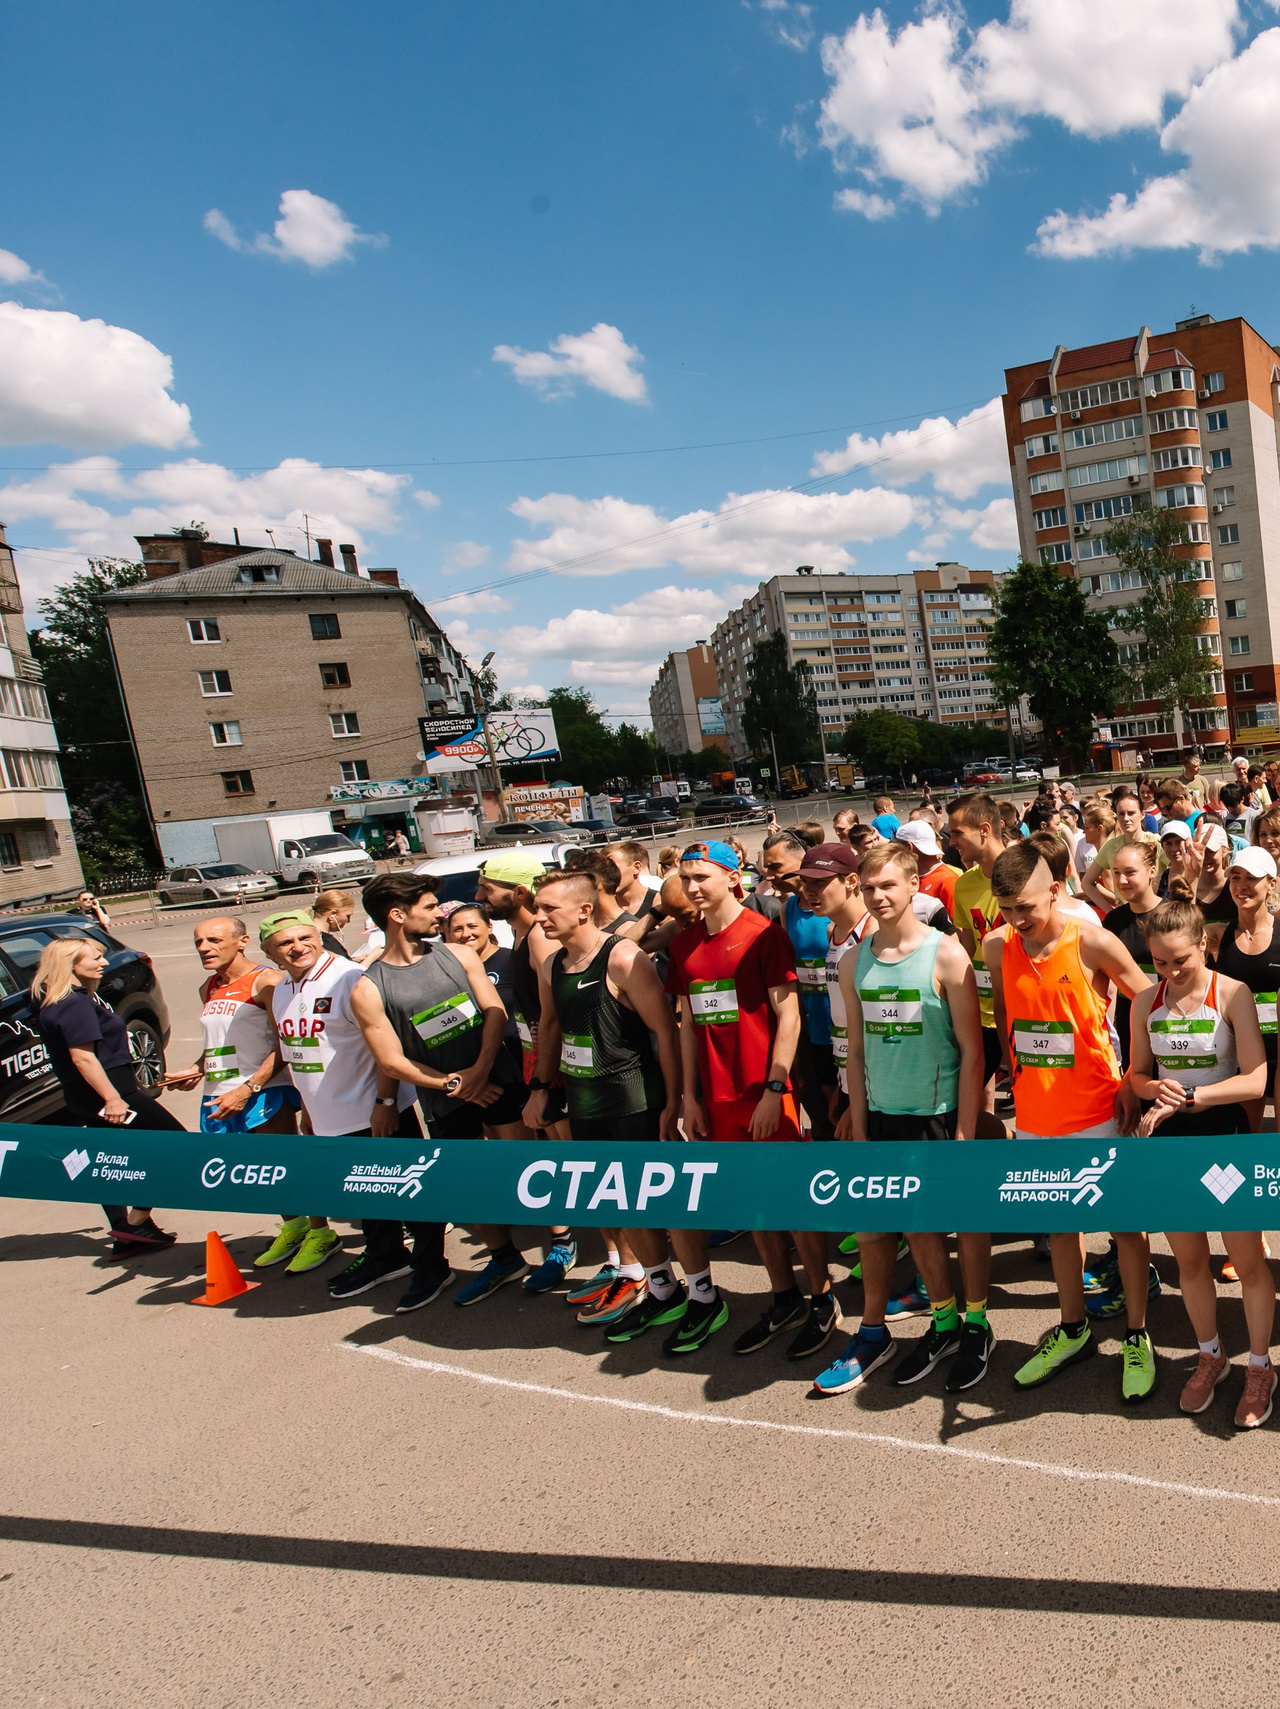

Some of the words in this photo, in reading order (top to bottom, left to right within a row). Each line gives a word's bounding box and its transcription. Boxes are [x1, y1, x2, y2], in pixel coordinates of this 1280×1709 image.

[423, 718, 475, 728] СКОРОСТНОЙ
[424, 724, 473, 733] ВЕЛОСИПЕД
[508, 788, 578, 803] КОНФЕТЫ
[514, 803, 553, 814] ПЕЧЕНЬЕ
[703, 998, 719, 1009] 342
[881, 1008, 899, 1018] 344
[440, 1014, 458, 1028] 346
[1032, 1039, 1050, 1049] 347
[1170, 1040, 1189, 1051] 339
[292, 1051, 304, 1060] 058
[95, 1151, 130, 1168] Вклад
[91, 1167, 99, 1178] в
[100, 1165, 147, 1182] будущее
[230, 1163, 287, 1186] СБЕР
[351, 1161, 402, 1177] ЗЕЛЁНЫЙ
[1005, 1168, 1071, 1183] ЗЕЛЁНЫЙ
[342, 1181, 398, 1195] МАРАФОН
[516, 1159, 719, 1212] СТАРТ
[847, 1174, 921, 1199] СБЕР
[1253, 1184, 1264, 1198] в
[1000, 1190, 1070, 1204] МАРАФОН
